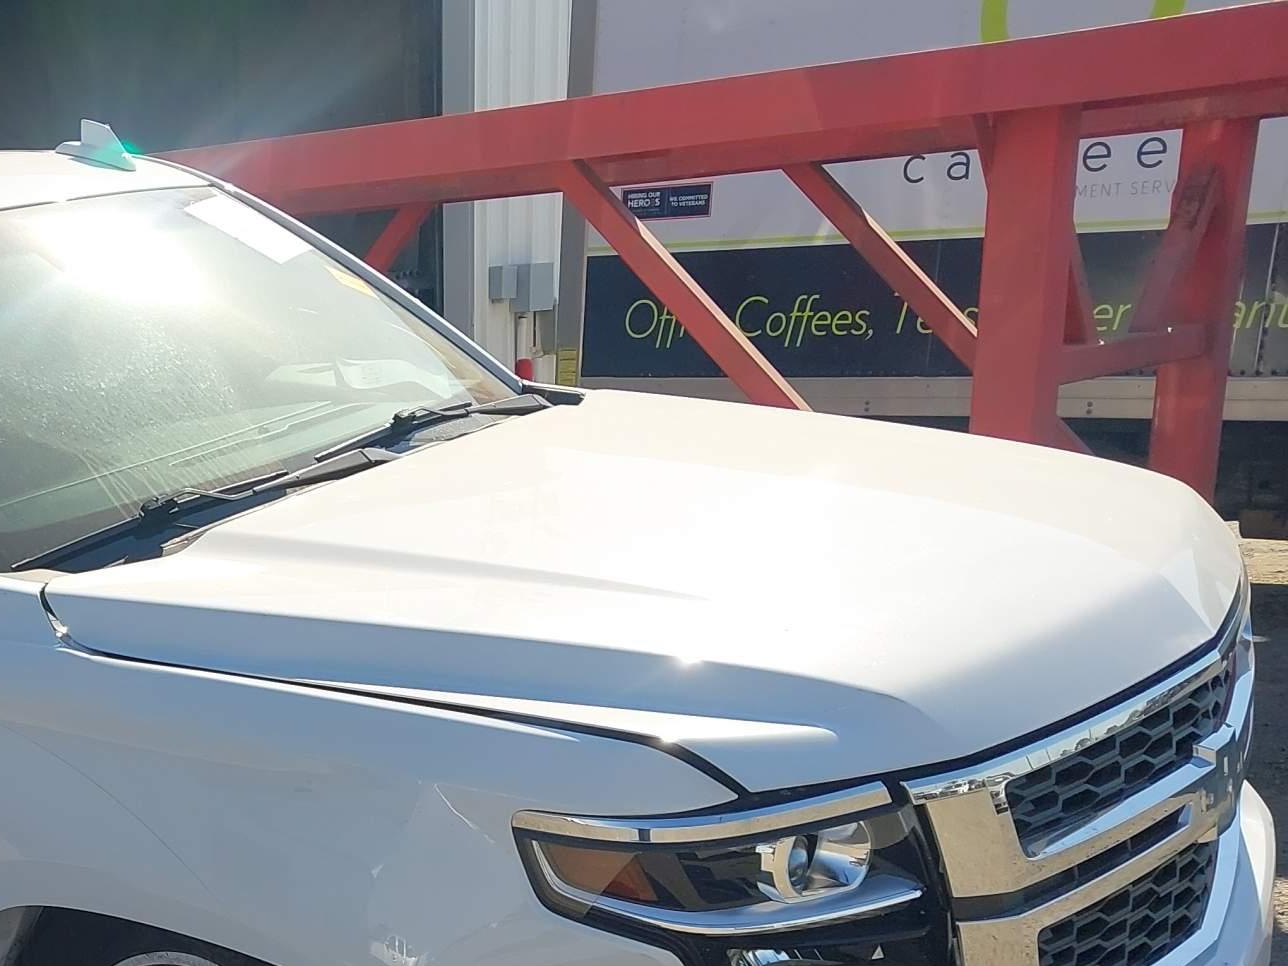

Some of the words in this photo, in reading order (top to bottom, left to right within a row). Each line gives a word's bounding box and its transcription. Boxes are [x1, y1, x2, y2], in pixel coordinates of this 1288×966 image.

[648, 191, 661, 199] OUR
[1130, 178, 1175, 196] SERV
[735, 295, 874, 348] Coffees,
